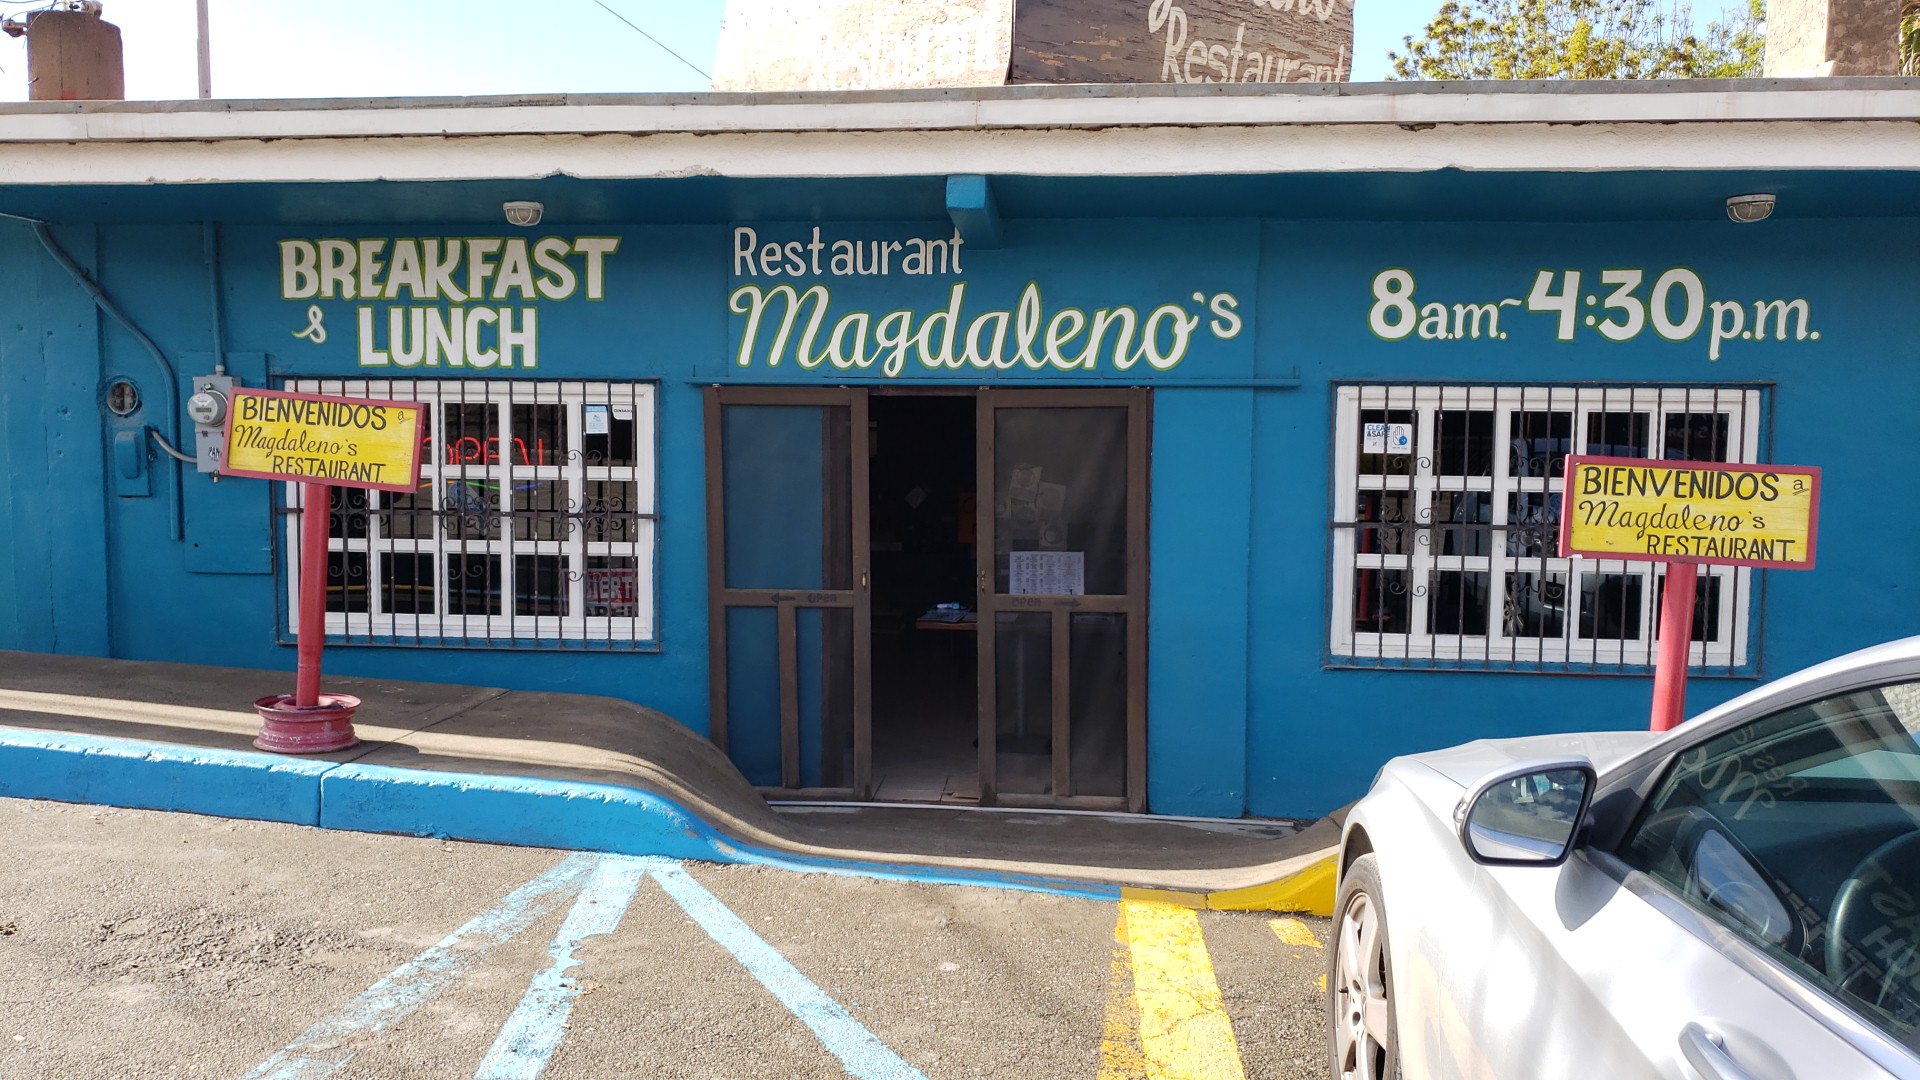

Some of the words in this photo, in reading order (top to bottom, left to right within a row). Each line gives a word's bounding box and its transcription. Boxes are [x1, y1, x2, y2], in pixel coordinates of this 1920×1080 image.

[1161, 5, 1345, 83] Restaurant
[278, 237, 622, 302] BREAKFAST
[733, 226, 964, 276] Restaurant
[358, 306, 538, 368] LUNCH
[729, 281, 1242, 377] Magdaleno's
[243, 397, 387, 431] BIENVENIDOS
[235, 424, 358, 459] Magdaleno's
[1583, 466, 1780, 501] BIENVENIDOS
[1578, 500, 1766, 541] Magdaleno's
